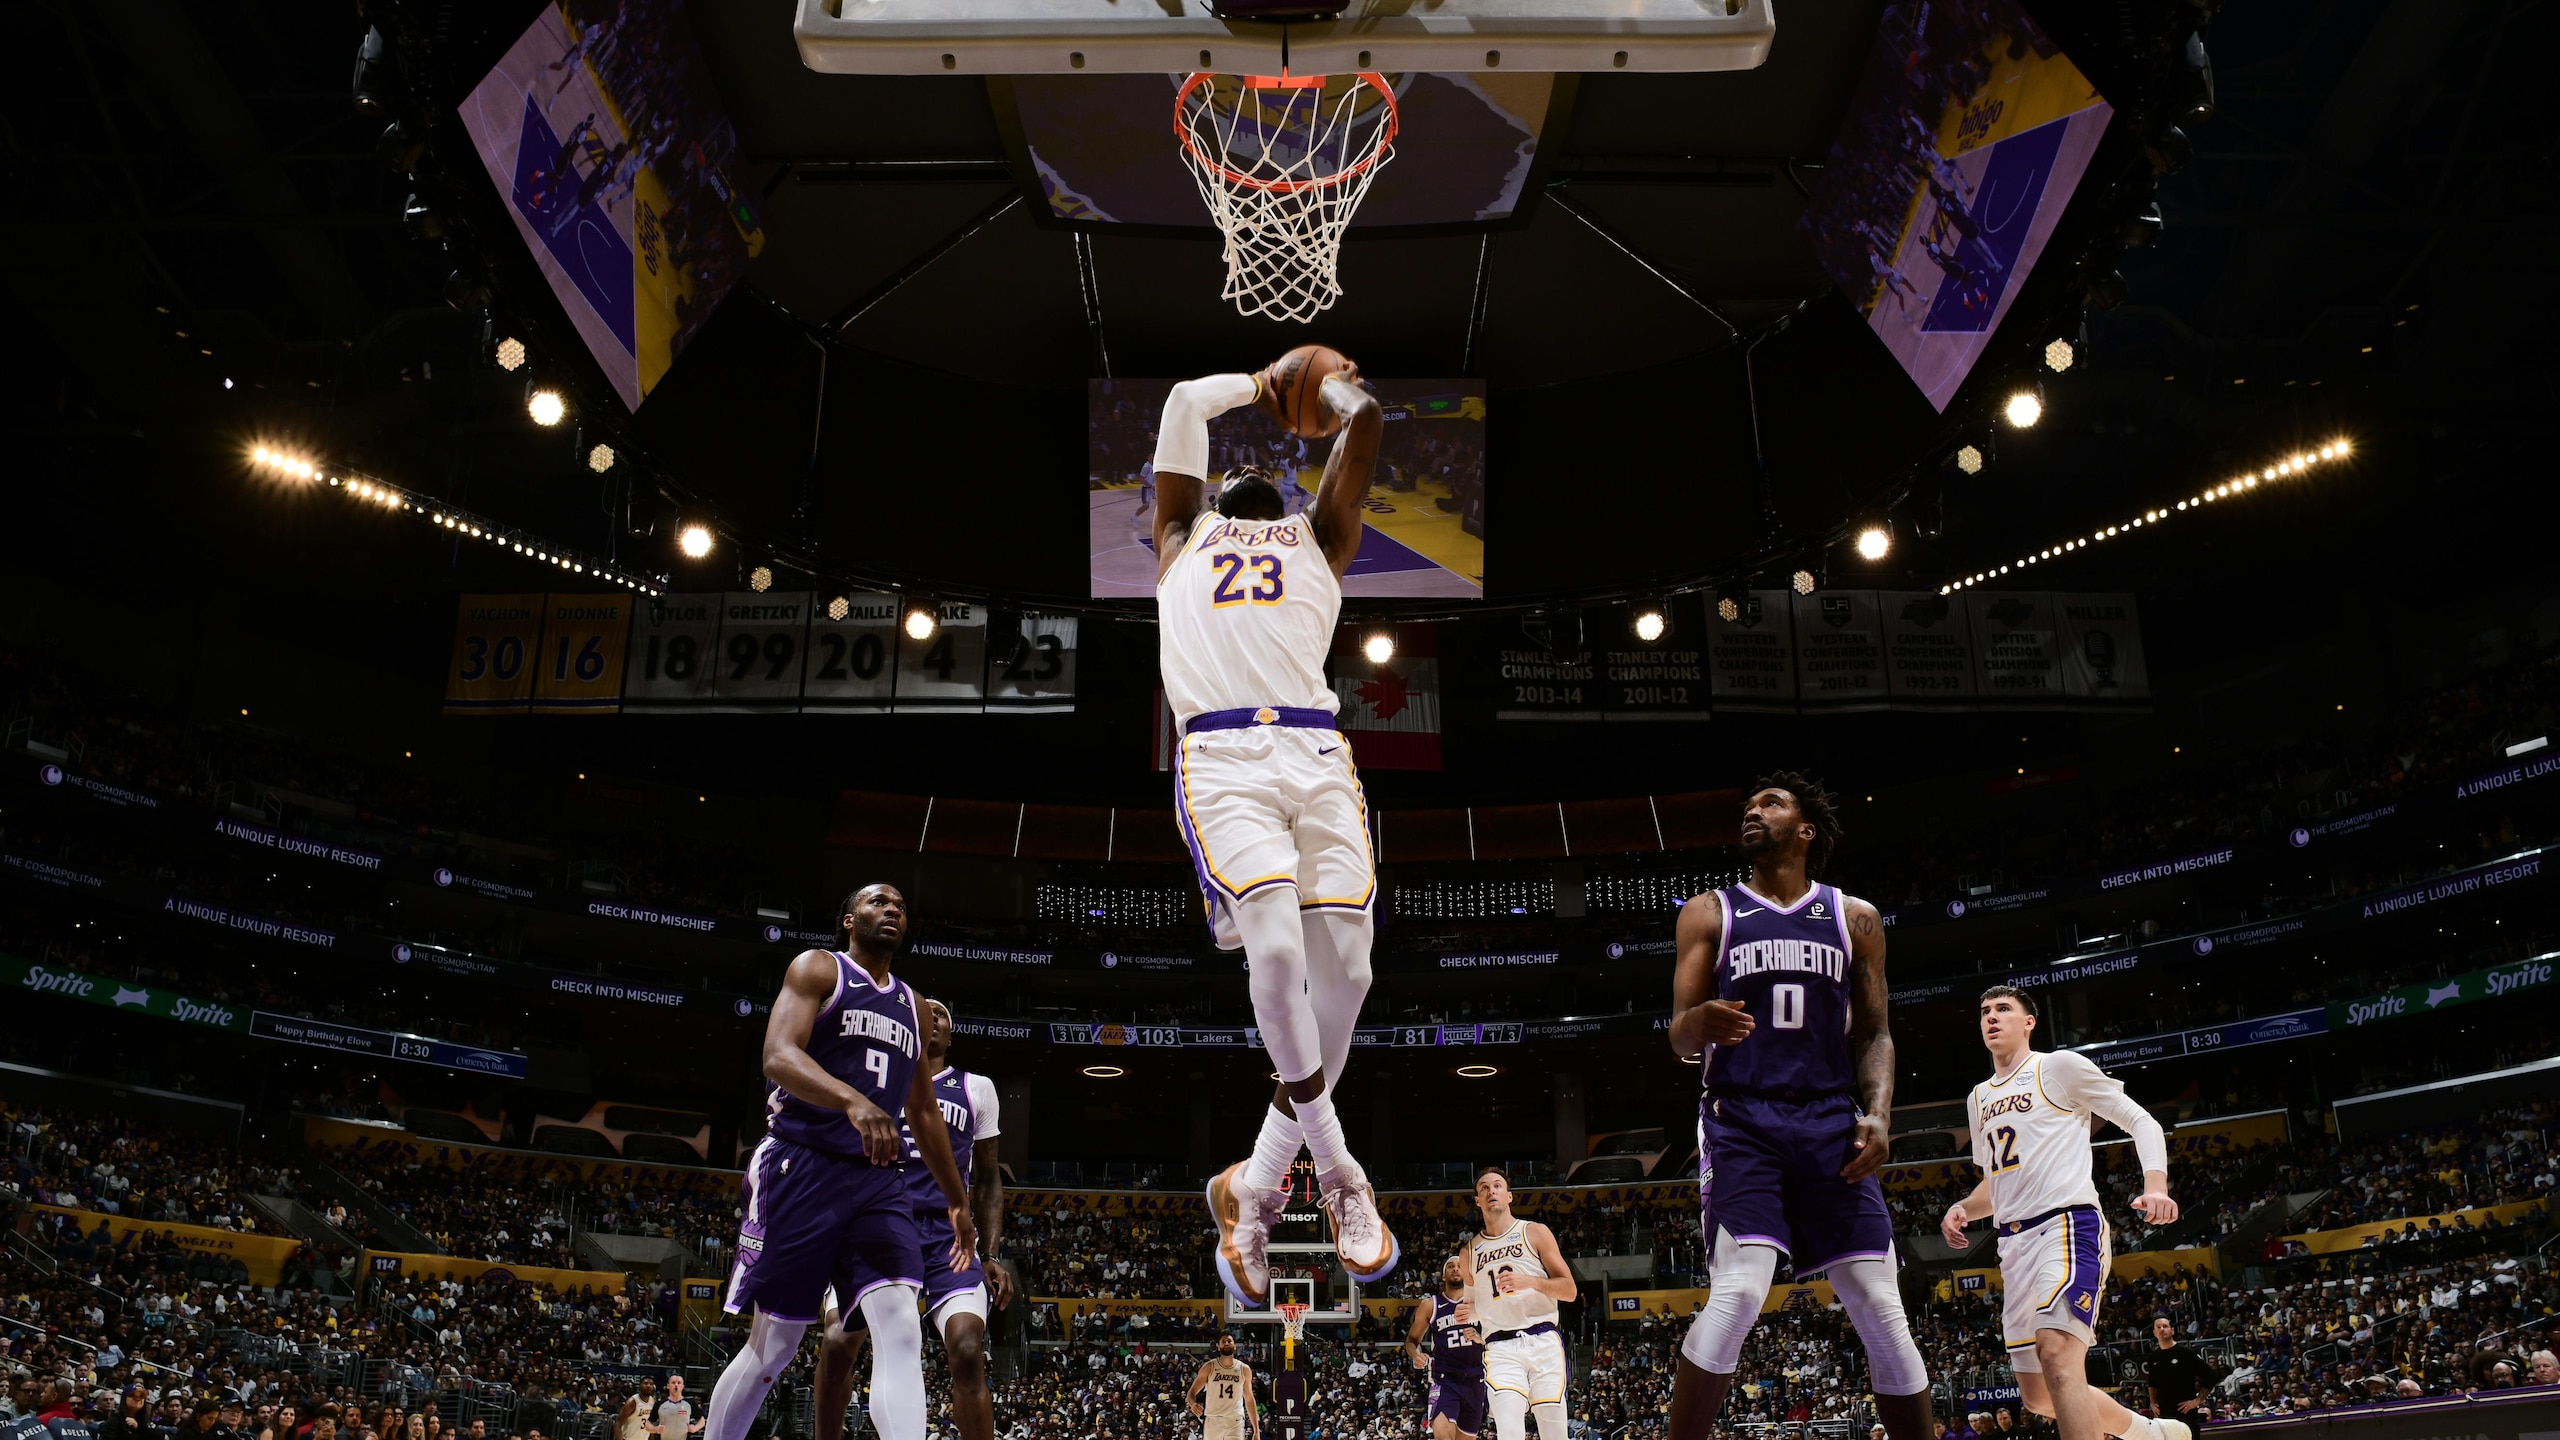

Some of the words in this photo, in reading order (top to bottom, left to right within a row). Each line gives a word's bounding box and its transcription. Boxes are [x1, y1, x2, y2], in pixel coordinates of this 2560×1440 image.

[1956, 99, 2004, 140] bibigo
[638, 200, 658, 277] bibigo
[1195, 522, 1299, 554] LAKERS
[1211, 552, 1286, 609] 23
[470, 607, 530, 620] VACHON
[557, 607, 619, 620] DIONNE
[729, 605, 799, 620] GRETZKY
[2066, 606, 2126, 620] MILLER
[1722, 633, 1776, 644] WESTERN
[1811, 634, 1867, 644] WESTERN
[1897, 634, 1956, 644] CAMPBELL
[1992, 634, 2037, 644] SMYTHE
[460, 634, 524, 682] 30
[554, 634, 606, 682] 16
[644, 634, 697, 681] 18
[728, 633, 796, 681] 99
[815, 633, 884, 681] 20
[923, 634, 955, 681] 4
[1001, 634, 1063, 681] 23
[1500, 650, 1554, 664] STANLE
[1607, 650, 1666, 664] STANLEY
[1670, 650, 1699, 664] CUP
[1714, 646, 1787, 658] CONFERENCE
[1803, 646, 1878, 658] CONFERENCE
[1892, 647, 1966, 658] CONFERENCE
[1991, 646, 2042, 658] DIVISION
[1501, 664, 1594, 680] CHAMPIONS
[1719, 659, 1784, 671] CHAMPIONS
[1808, 659, 1876, 671] CHAMPIONS
[1896, 660, 1964, 671] CHAMPIONS
[1984, 660, 2052, 671] CHAMPIONS
[1607, 666, 1701, 681] CHAMPIONS
[1728, 675, 1776, 689] 2013-14
[1819, 676, 1867, 690] 2011-12
[1905, 676, 1959, 690] 1992-93
[1993, 676, 2047, 689] 1990-91
[1514, 685, 1583, 704] 2013-14
[1624, 687, 1688, 704] 2011-12
[65, 772, 83, 788] THE
[86, 780, 156, 807] COSMOPOLITAN
[2456, 786, 2467, 800] A
[2469, 769, 2523, 796] UNIQUE
[2311, 824, 2328, 837] THE
[2330, 806, 2394, 834] COSMOPOLITAN
[215, 822, 226, 838] A
[228, 824, 275, 846] UNIQUE
[279, 838, 328, 857] LUXURY
[332, 850, 380, 868] RESORT
[2, 853, 23, 869] THE
[25, 861, 101, 886] COSMOPOLITAN
[2101, 872, 2141, 888] CHECK
[2144, 865, 2171, 879] INTO
[2174, 851, 2232, 872] MISCHIEF
[455, 874, 470, 886] THE
[472, 878, 533, 900] COSMOPOLITAN
[2363, 905, 2374, 919] A
[2375, 892, 2425, 914] UNIQUE
[2429, 877, 2480, 900] LUXURY
[2485, 861, 2542, 888] RESORT
[1984, 889, 2047, 908] COSMOPOLITAN
[165, 899, 173, 911] A
[178, 902, 227, 924] UNIQUE
[230, 915, 280, 936] LUXURY
[283, 928, 335, 946] RESORT
[589, 904, 628, 918] CHECK
[631, 910, 658, 922] INTO
[661, 915, 715, 930] MISCHIEF
[784, 930, 798, 941] THE
[2215, 935, 2231, 944] THE
[2233, 921, 2303, 942] COSMOPOLITAN
[910, 943, 920, 955] A
[922, 945, 963, 957] UNIQUE
[967, 949, 1008, 961] LUXURY
[1011, 953, 1052, 964] RESORT
[1625, 944, 1639, 952] THE
[415, 951, 429, 960] THE
[431, 955, 496, 975] COSMOPOLITAN
[1135, 956, 1192, 966] COSMOPOLITAN
[1440, 957, 1476, 967] CHECK
[1480, 956, 1504, 965] INTO
[1507, 954, 1558, 964] MISCHIEF
[1728, 938, 1844, 984] SACRAMENTO
[2006, 972, 2050, 988] CHECK
[2051, 967, 2078, 983] INTO
[2081, 955, 2139, 977] MISCHIEF
[22, 965, 95, 998] Sprite
[169, 997, 235, 1028] Sprite
[552, 980, 592, 994] CHECK
[596, 985, 623, 998] INTO
[627, 990, 683, 1005] MISCHIEF
[1888, 985, 1950, 1001] COSMOPOLITAN
[2346, 993, 2407, 1027] Sprite
[2484, 962, 2552, 996] Sprite
[1772, 983, 1805, 1029] 0
[275, 1023, 304, 1039] Happy
[306, 1028, 345, 1047] Birthday
[346, 1035, 372, 1048] Elove
[839, 1008, 914, 1058] SACRAMENTO
[950, 1022, 985, 1036] UXURY
[988, 1025, 1032, 1039] RESORT
[1095, 1027, 1137, 1044] LAKERS
[1541, 1024, 1601, 1035] COSMOPOLITAN
[2288, 1022, 2310, 1033] Bank
[1059, 1031, 1067, 1043] 3
[1078, 1031, 1087, 1043] 0
[1141, 1028, 1176, 1045] 103
[1195, 1033, 1233, 1043] Lakers
[1351, 1033, 1376, 1045] ings
[1404, 1028, 1428, 1044] 81
[1444, 1031, 1476, 1041] KINGS
[1489, 1032, 1496, 1042] 1
[1508, 1032, 1516, 1042] 3
[2190, 1032, 2220, 1048] 8:30
[400, 1041, 430, 1058] 8:30
[2102, 1047, 2138, 1063] Birthday
[2139, 1044, 2163, 1056] Elove
[492, 1061, 510, 1072] Bank
[865, 1048, 890, 1089] 9
[1980, 1093, 2033, 1131] LAKERS
[1987, 1125, 2020, 1176] 12
[353, 1137, 421, 1157] LOS
[594, 1163, 729, 1188] LAKERS
[1377, 1195, 1427, 1211] LOS
[1281, 1213, 1319, 1223] TISSOT
[739, 1234, 764, 1252] KINGS
[374, 1257, 396, 1272] 114
[1476, 1244, 1523, 1274] LAKERS
[1962, 1276, 1981, 1289] 117
[691, 1286, 711, 1298] 115
[1616, 1298, 1636, 1310] 116
[1213, 1372, 1241, 1385] LAKERS
[1218, 1383, 1234, 1399] 14
[1977, 1390, 1993, 1401] 17x
[25, 1424, 47, 1437] DELTA
